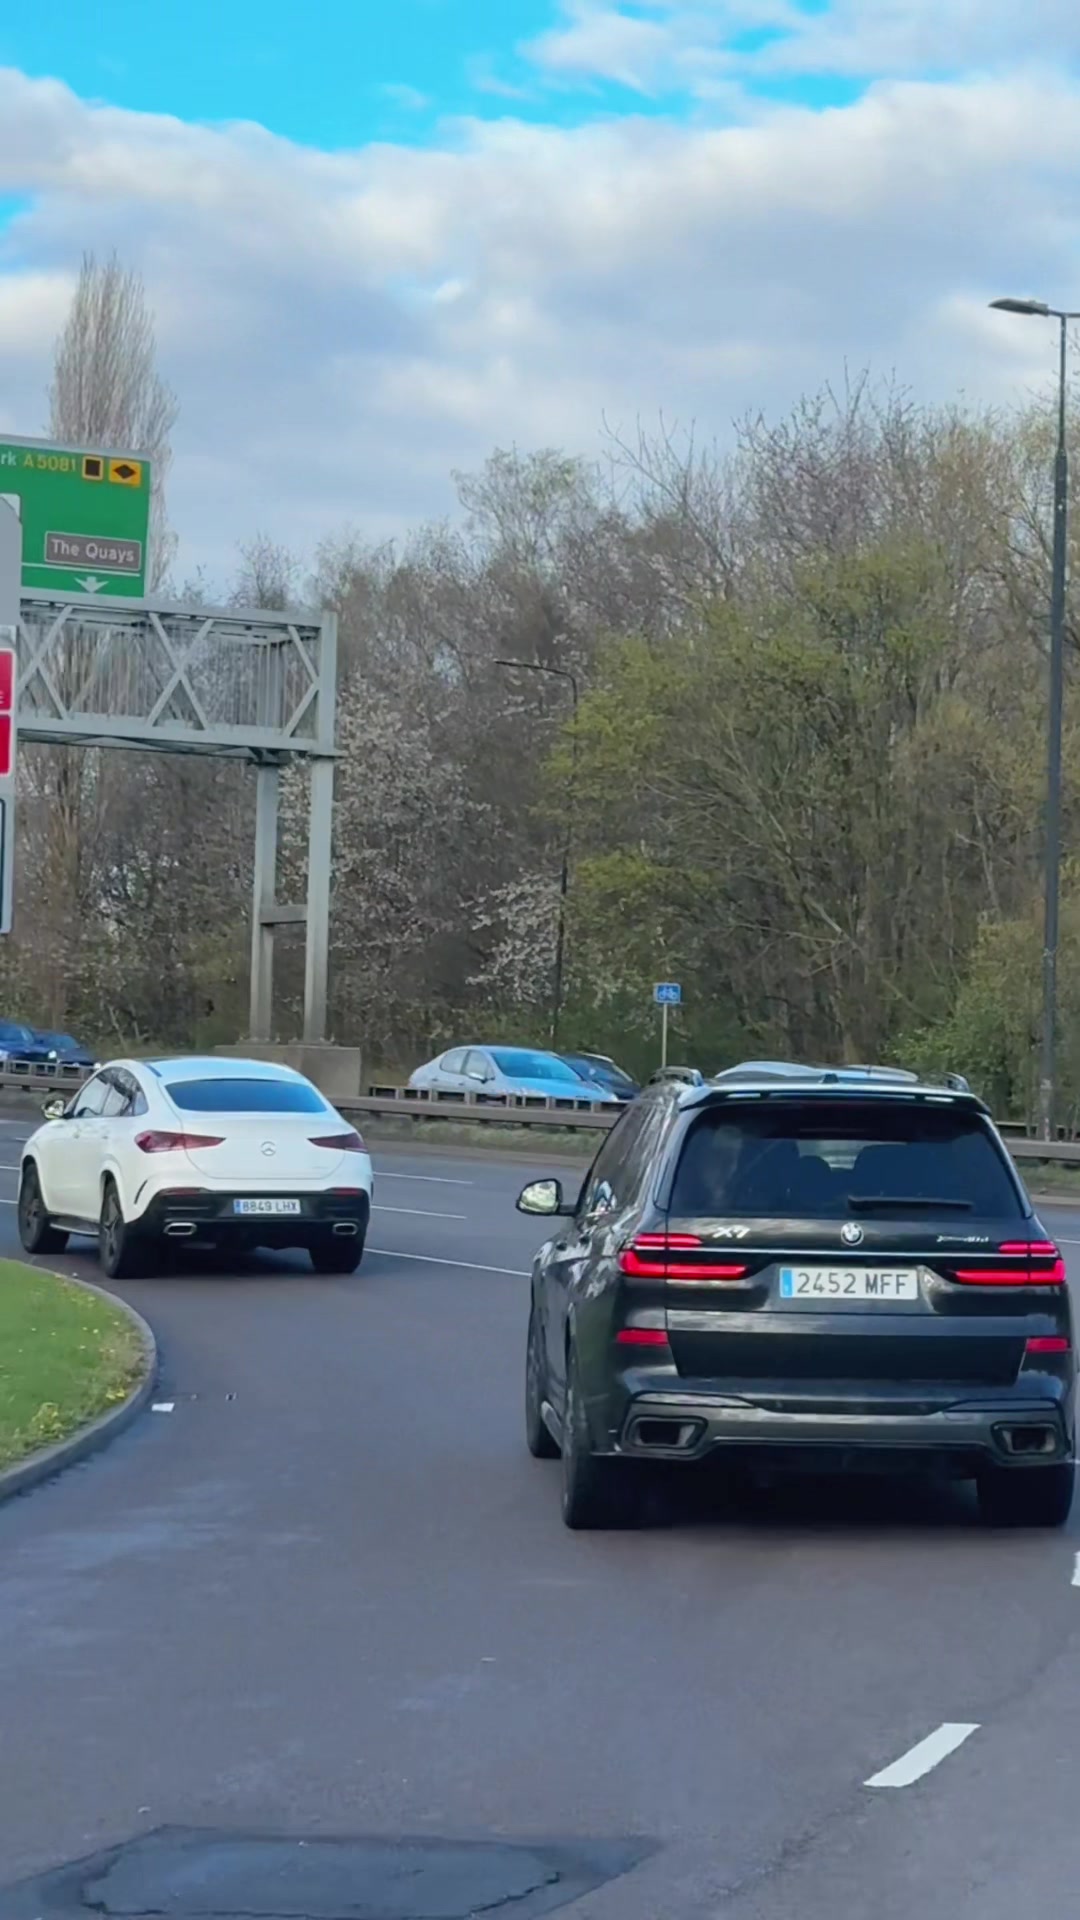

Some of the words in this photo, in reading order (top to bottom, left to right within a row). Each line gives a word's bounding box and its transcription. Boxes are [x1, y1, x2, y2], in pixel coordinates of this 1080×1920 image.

[51, 539, 80, 556] The
[85, 542, 134, 564] Quays
[275, 1201, 298, 1213] LHX
[712, 1225, 751, 1238] X7
[797, 1272, 857, 1294] 2452
[865, 1273, 909, 1295] MFF
